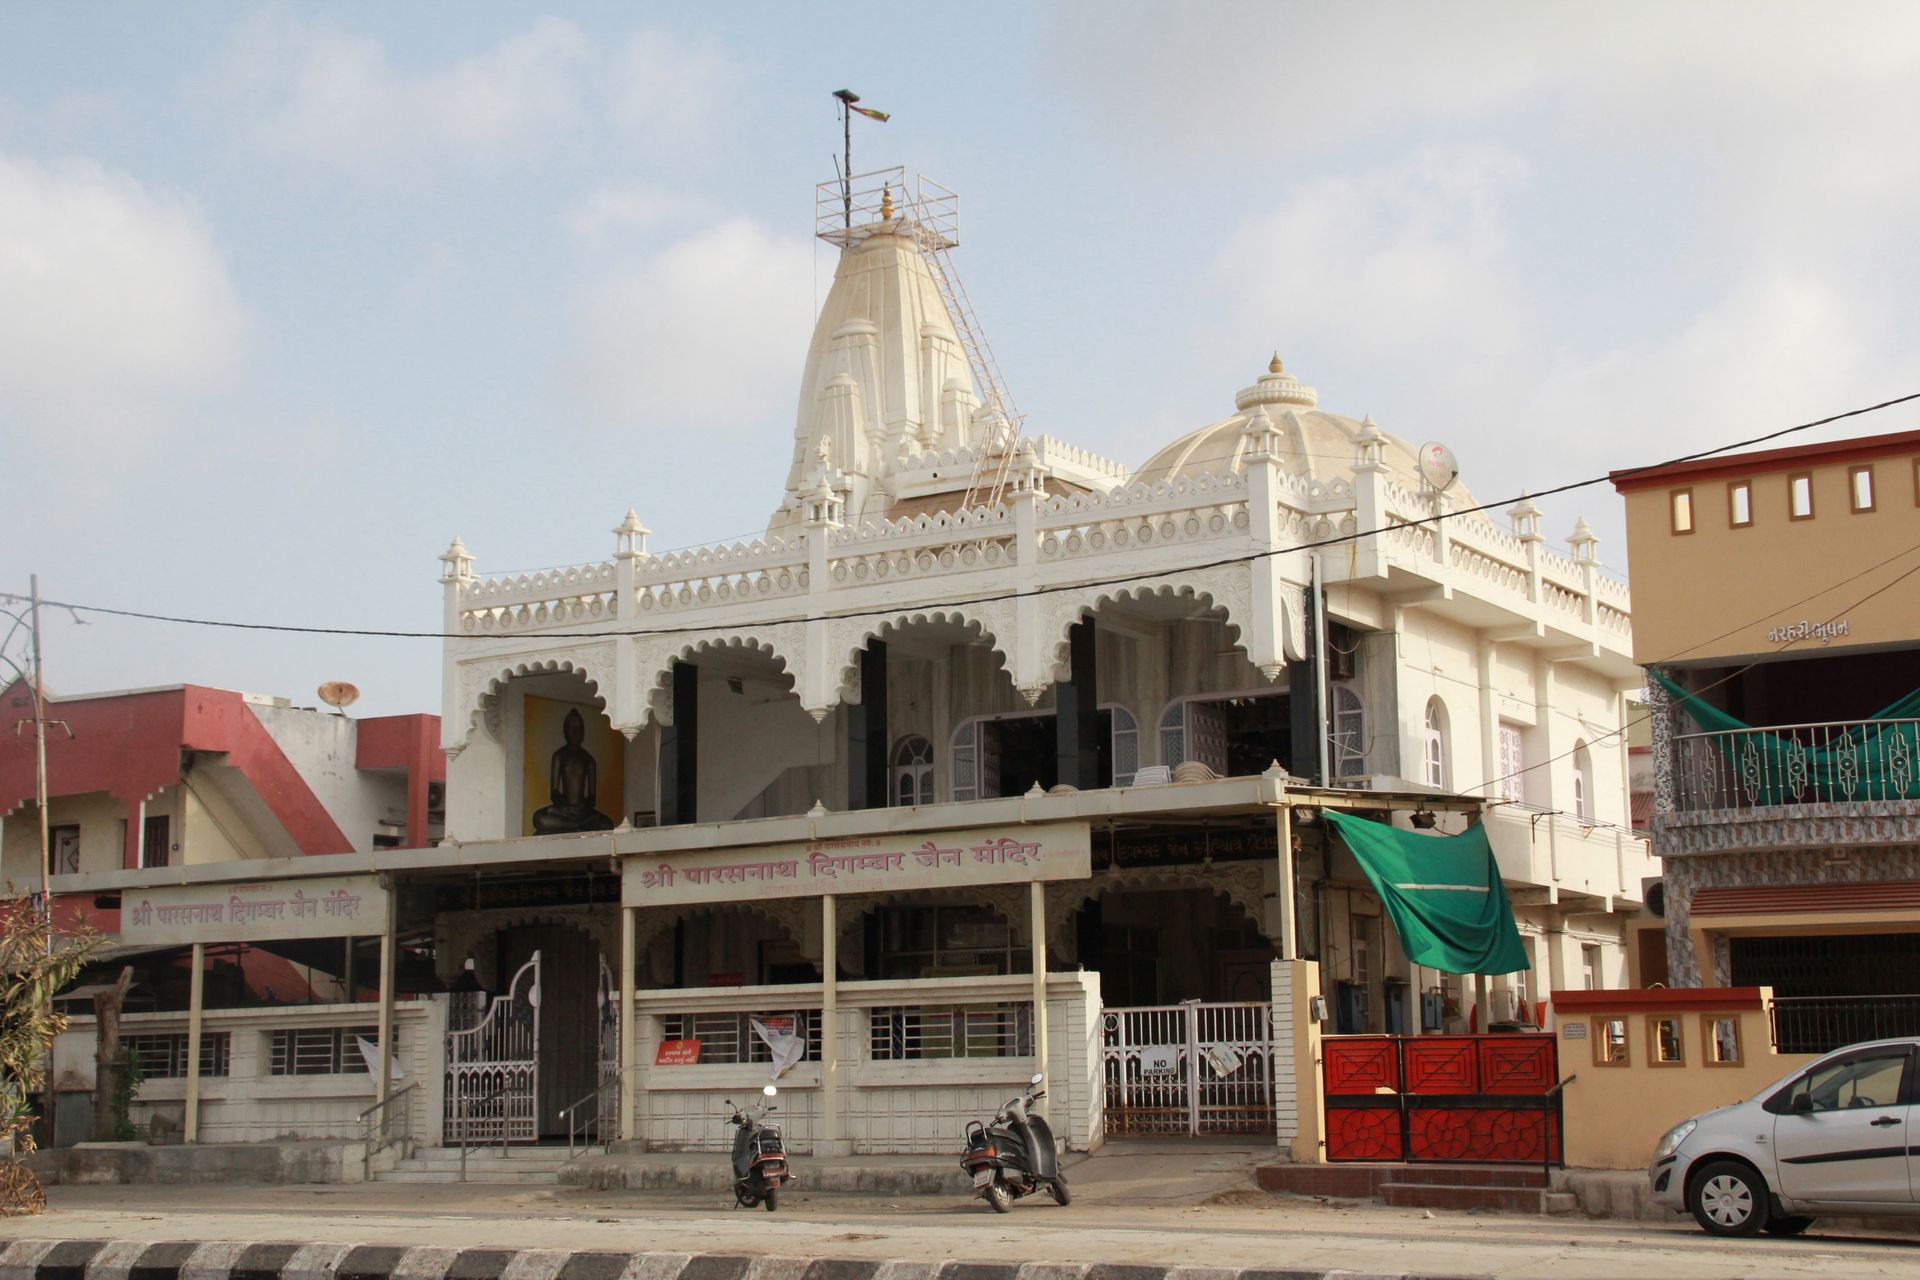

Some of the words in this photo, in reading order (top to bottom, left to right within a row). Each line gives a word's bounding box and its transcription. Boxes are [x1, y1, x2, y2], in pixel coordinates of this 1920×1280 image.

[640, 864, 677, 888] श्री
[682, 859, 799, 885] पारसनाथ
[806, 851, 905, 880] दिगम्बर
[911, 841, 964, 869] जैन
[969, 838, 1042, 866] मंदिर
[131, 900, 153, 926] श्री
[156, 904, 224, 926] पारसनाथ
[229, 896, 286, 926] दिगम्बर
[289, 890, 318, 918] जैन
[322, 889, 362, 921] मंदिर
[1144, 1067, 1174, 1075] PARKING
[1154, 1060, 1167, 1068] NO
